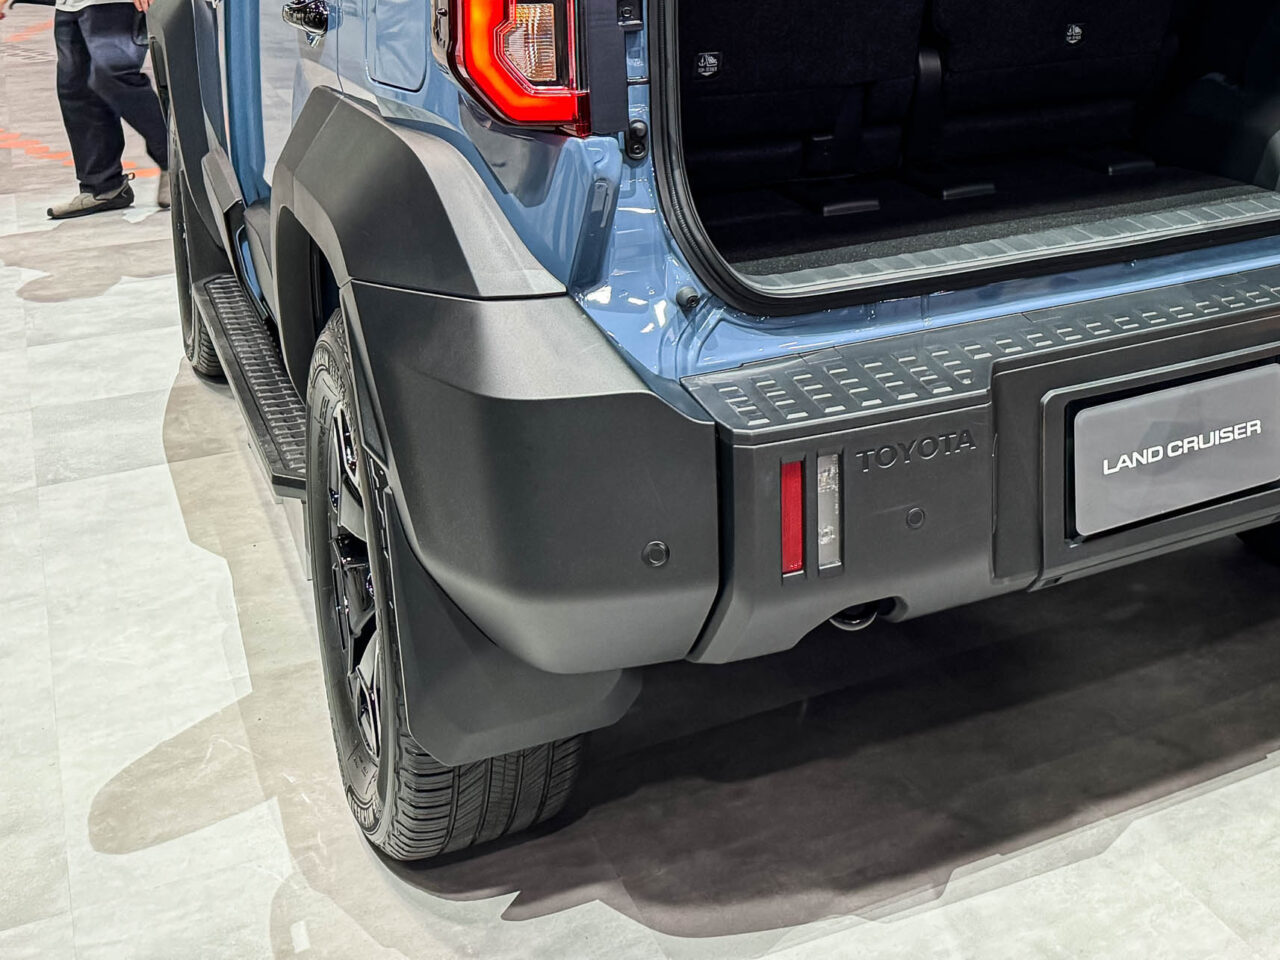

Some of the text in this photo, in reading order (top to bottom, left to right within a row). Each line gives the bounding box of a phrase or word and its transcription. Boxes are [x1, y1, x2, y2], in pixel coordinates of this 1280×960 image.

[855, 429, 977, 473] TOYOTA
[1103, 419, 1262, 475] LAND CRUISER
